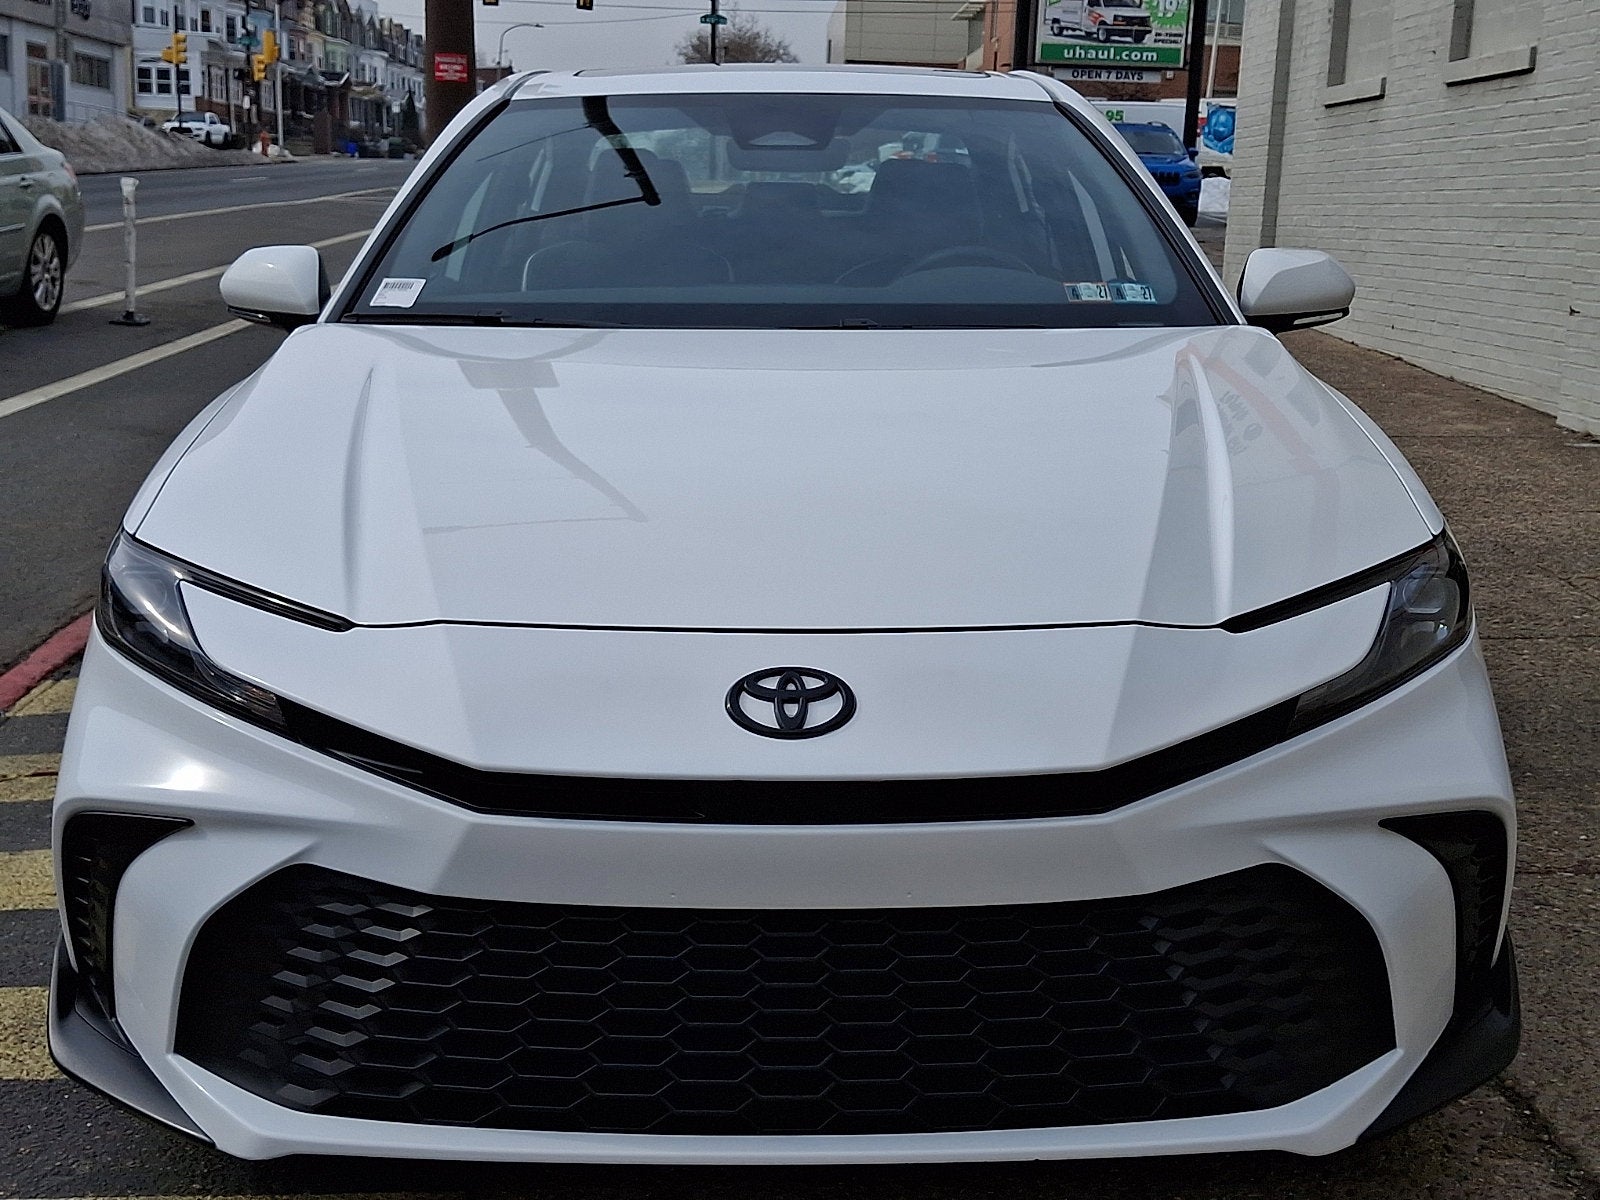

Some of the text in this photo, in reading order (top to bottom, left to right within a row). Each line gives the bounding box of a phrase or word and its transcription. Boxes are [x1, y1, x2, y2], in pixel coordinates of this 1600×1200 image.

[1064, 46, 1157, 61] uhaul.com
[1072, 70, 1144, 80] OPEN 7 DAYS
